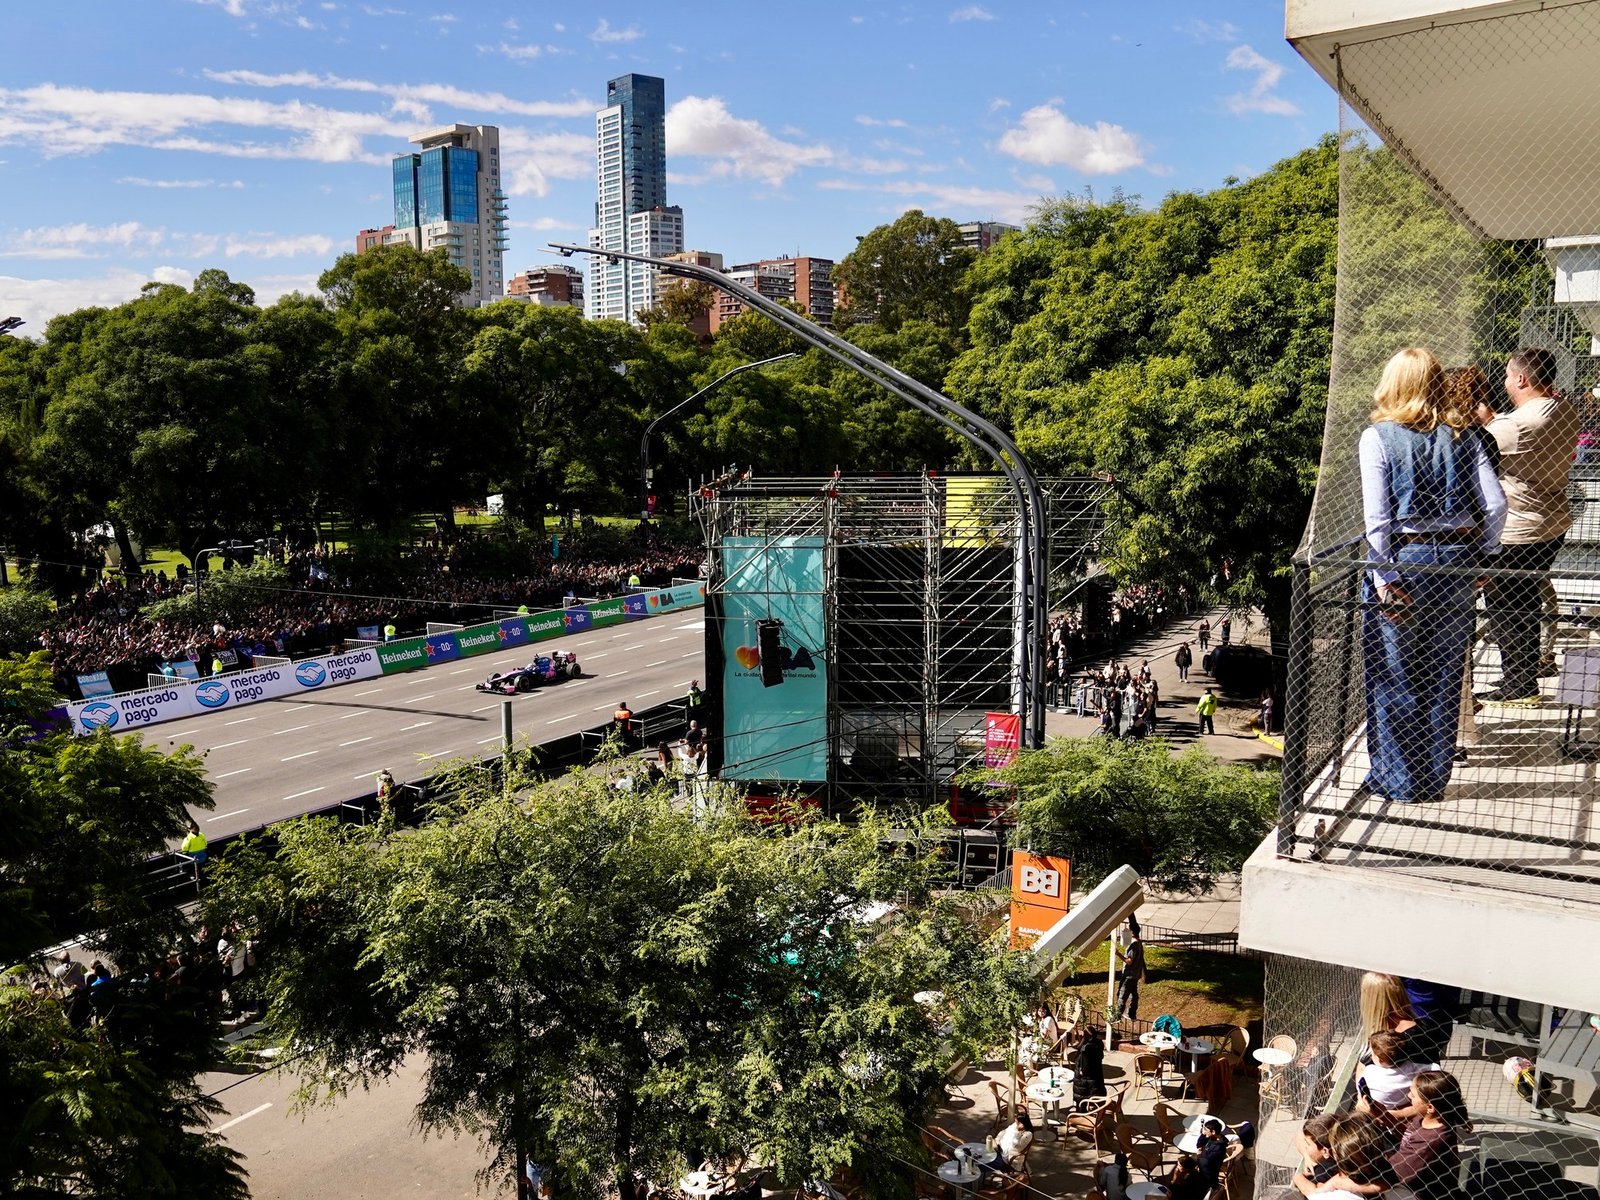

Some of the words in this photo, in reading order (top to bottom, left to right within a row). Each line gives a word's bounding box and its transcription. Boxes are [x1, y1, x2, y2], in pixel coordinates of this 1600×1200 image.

[591, 605, 621, 619] Heineken
[528, 618, 562, 633] Heineken
[459, 633, 496, 648] Heineken
[327, 652, 372, 669] mercado
[380, 648, 423, 665] Heineken
[230, 669, 281, 689] mercado
[330, 666, 357, 682] pago
[121, 690, 179, 710] mercado
[234, 685, 264, 702] pago
[124, 706, 158, 724] pago
